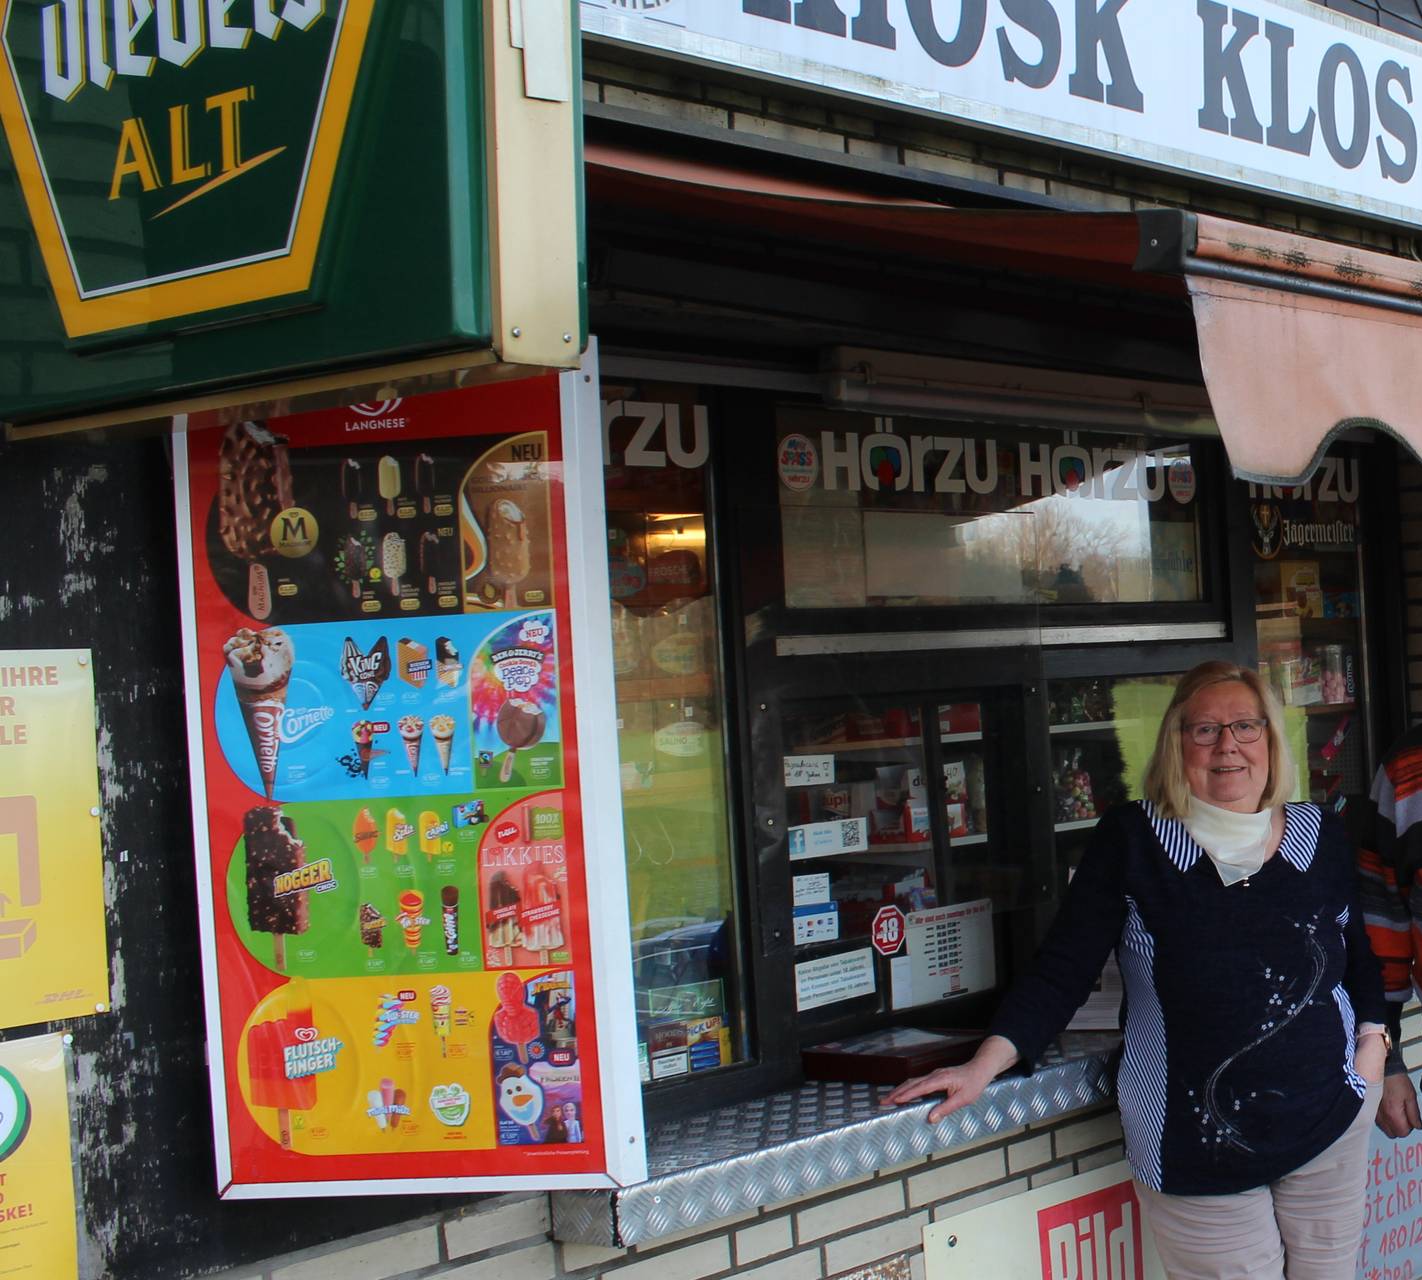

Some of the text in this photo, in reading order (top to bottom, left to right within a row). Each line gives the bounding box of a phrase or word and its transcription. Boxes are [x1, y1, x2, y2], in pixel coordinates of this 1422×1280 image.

[1196, 0, 1418, 184] KLOS
[108, 85, 255, 200] ALT
[344, 417, 405, 432] LANGNESE
[511, 443, 542, 462] NEU
[437, 527, 453, 537] NEU
[1282, 517, 1355, 548] Jägermeister
[1, 666, 58, 687] IHRE
[501, 667, 536, 680] peace
[0, 696, 16, 716] R
[0, 724, 27, 745] LE
[276, 705, 335, 743] Cornetto
[275, 862, 333, 895] NOGGER
[399, 992, 415, 1000] NEU
[283, 1037, 344, 1061] FLUTSCH-
[552, 1052, 571, 1062] NEU
[284, 1053, 334, 1077] FINGER
[0, 1203, 33, 1223] SKE!
[1046, 1201, 1139, 1280] Bild
